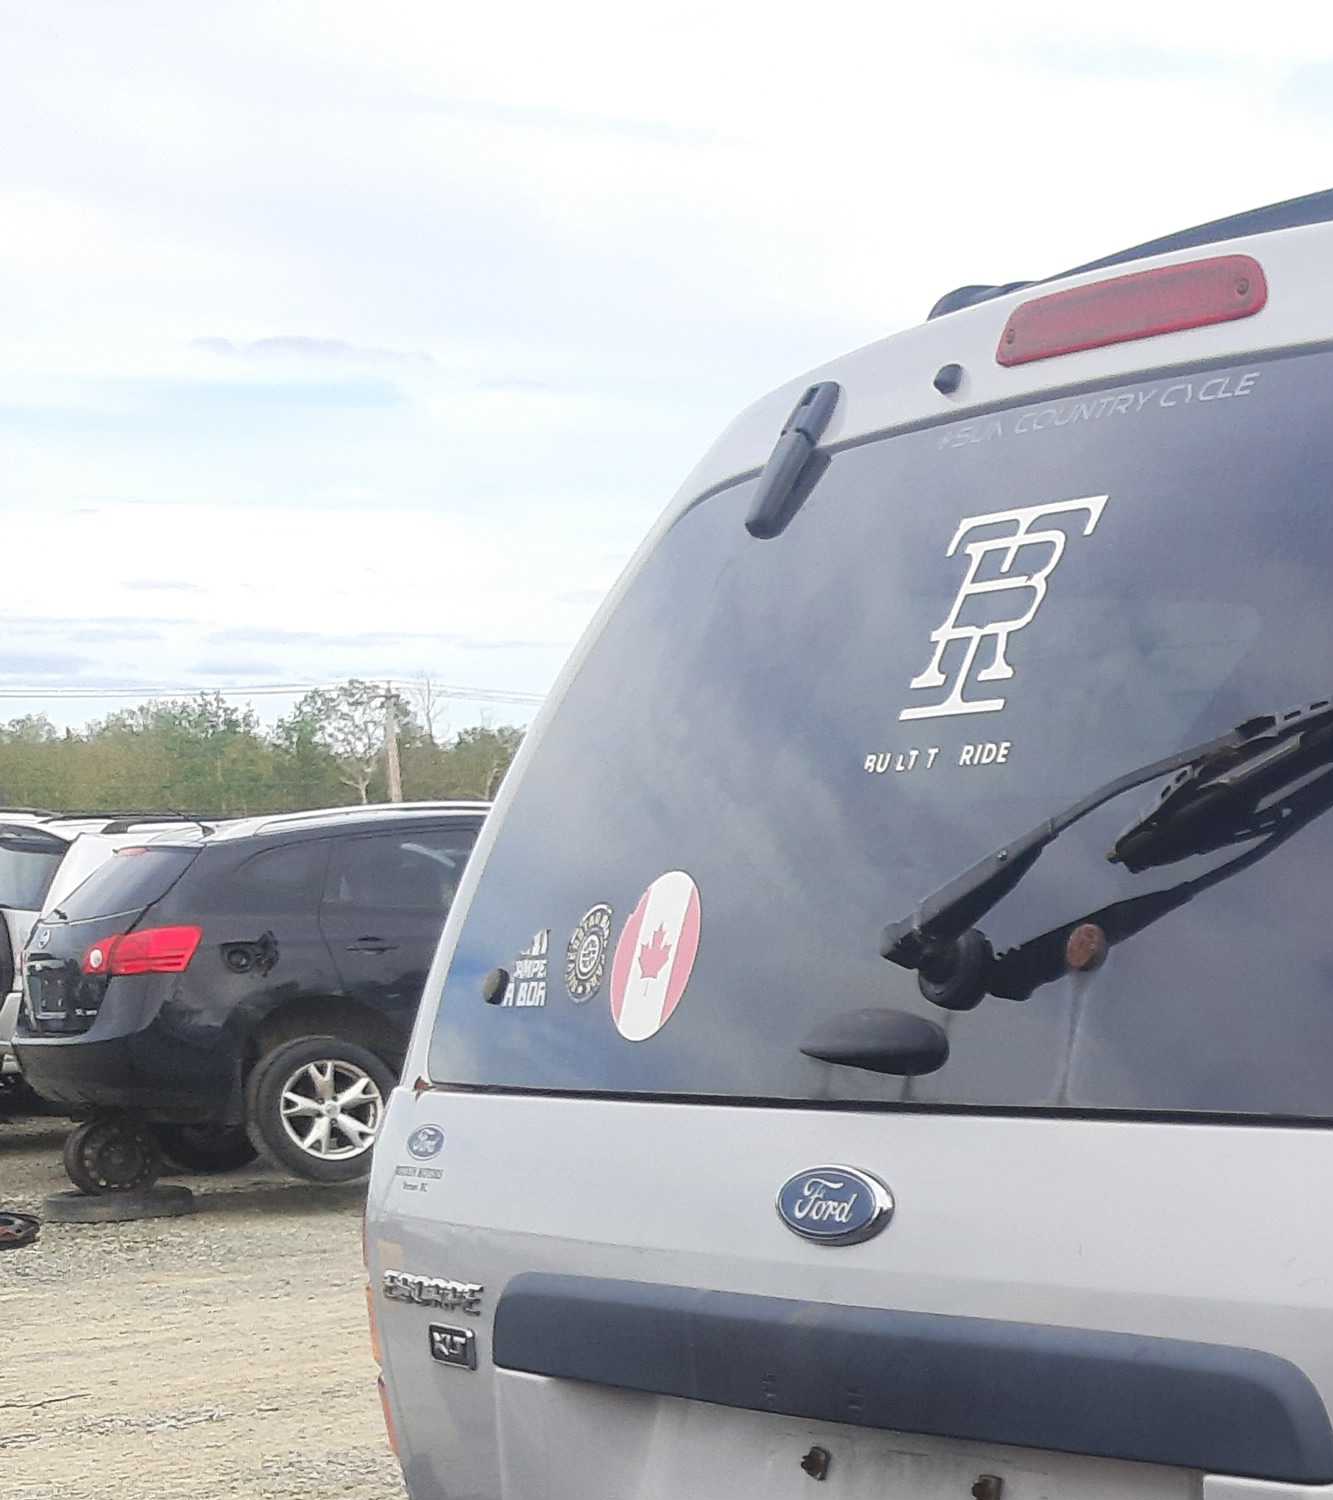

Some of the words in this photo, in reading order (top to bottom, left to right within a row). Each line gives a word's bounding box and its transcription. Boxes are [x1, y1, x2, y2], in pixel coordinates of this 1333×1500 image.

[1015, 389, 1154, 435] COUNTRY
[959, 741, 1012, 766] RIDE
[794, 1178, 858, 1223] Ford
